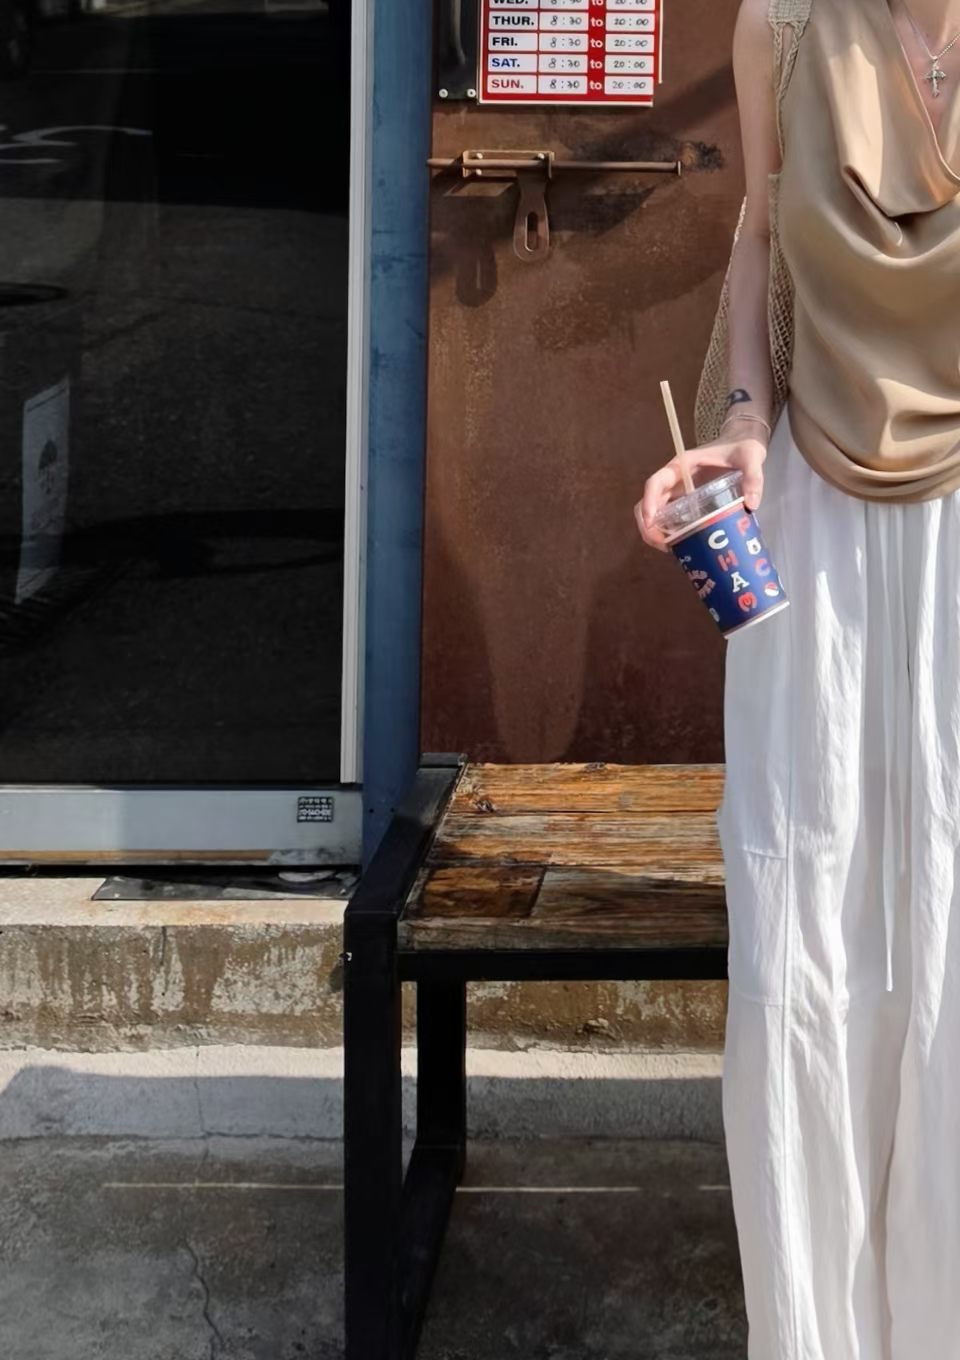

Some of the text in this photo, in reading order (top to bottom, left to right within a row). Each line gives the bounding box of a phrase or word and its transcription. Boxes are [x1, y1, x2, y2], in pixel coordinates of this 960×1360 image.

[492, 16, 535, 26] THUR.
[591, 17, 604, 27] to
[492, 37, 518, 47] FRI.
[590, 38, 603, 48] to
[491, 58, 521, 68] SAT.
[590, 59, 603, 69] to
[491, 79, 524, 89] SUN.
[590, 80, 603, 90] to
